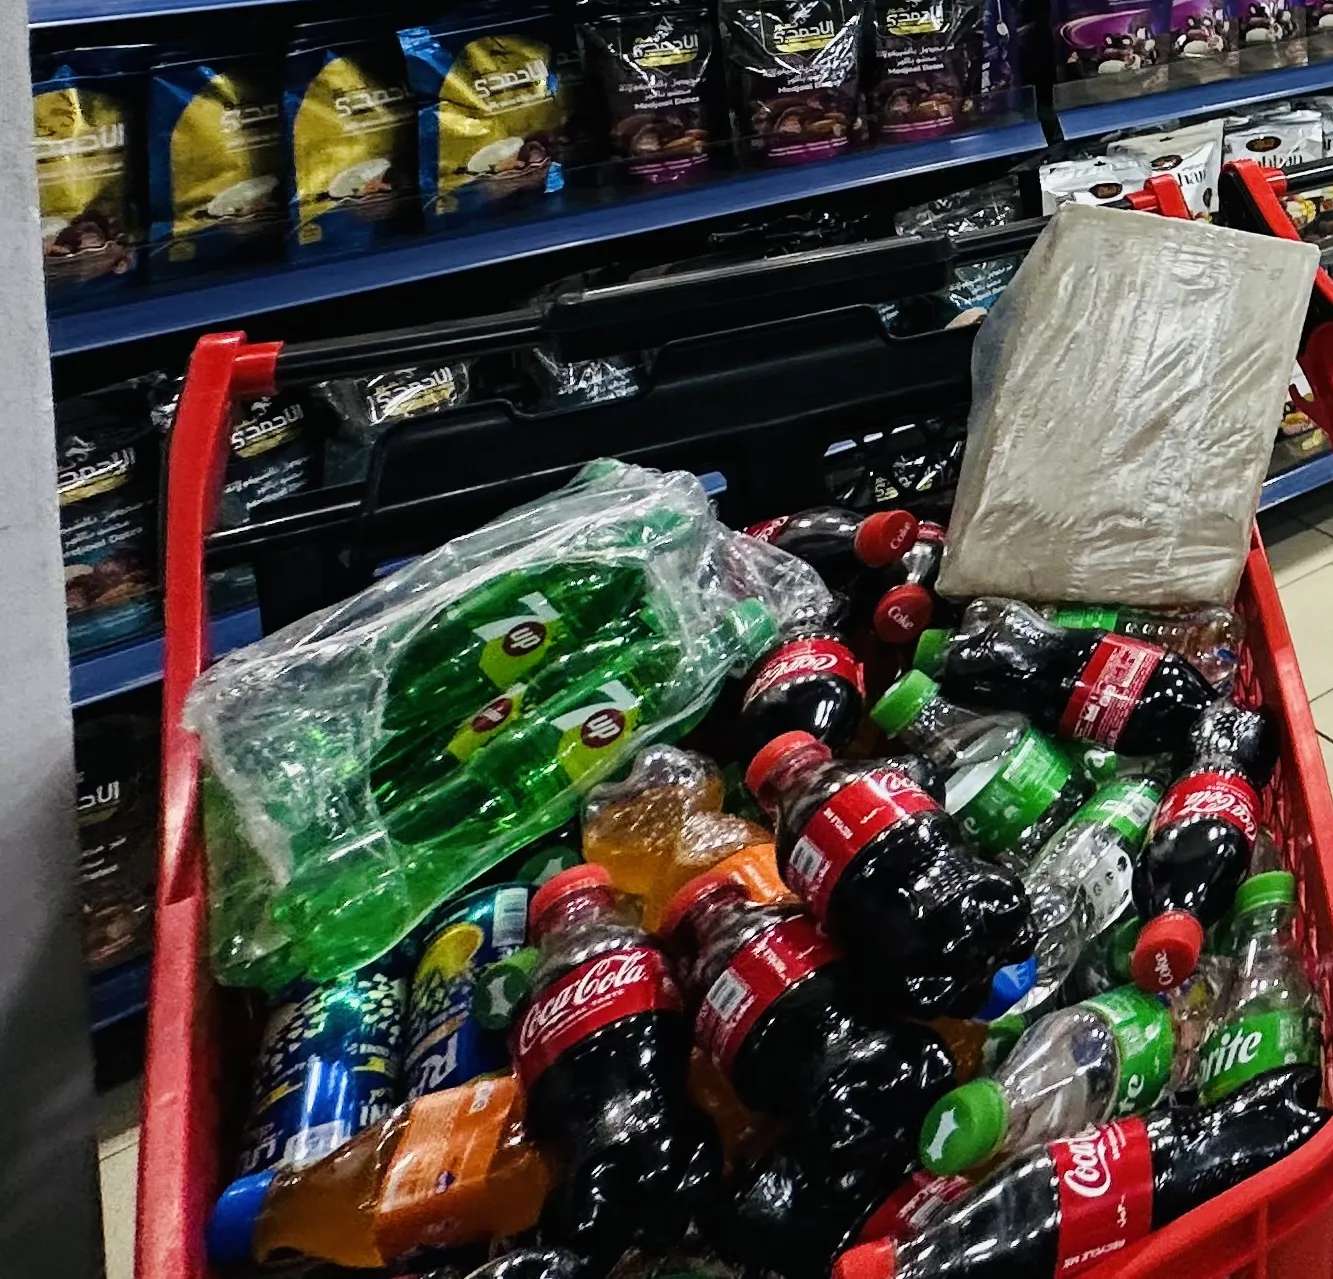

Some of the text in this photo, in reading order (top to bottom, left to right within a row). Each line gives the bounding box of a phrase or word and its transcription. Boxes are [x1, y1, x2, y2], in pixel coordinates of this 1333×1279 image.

[889, 521, 912, 550] Coke
[887, 605, 914, 631] Coke
[1154, 948, 1174, 985] Coke
[1199, 1027, 1263, 1084] rite
